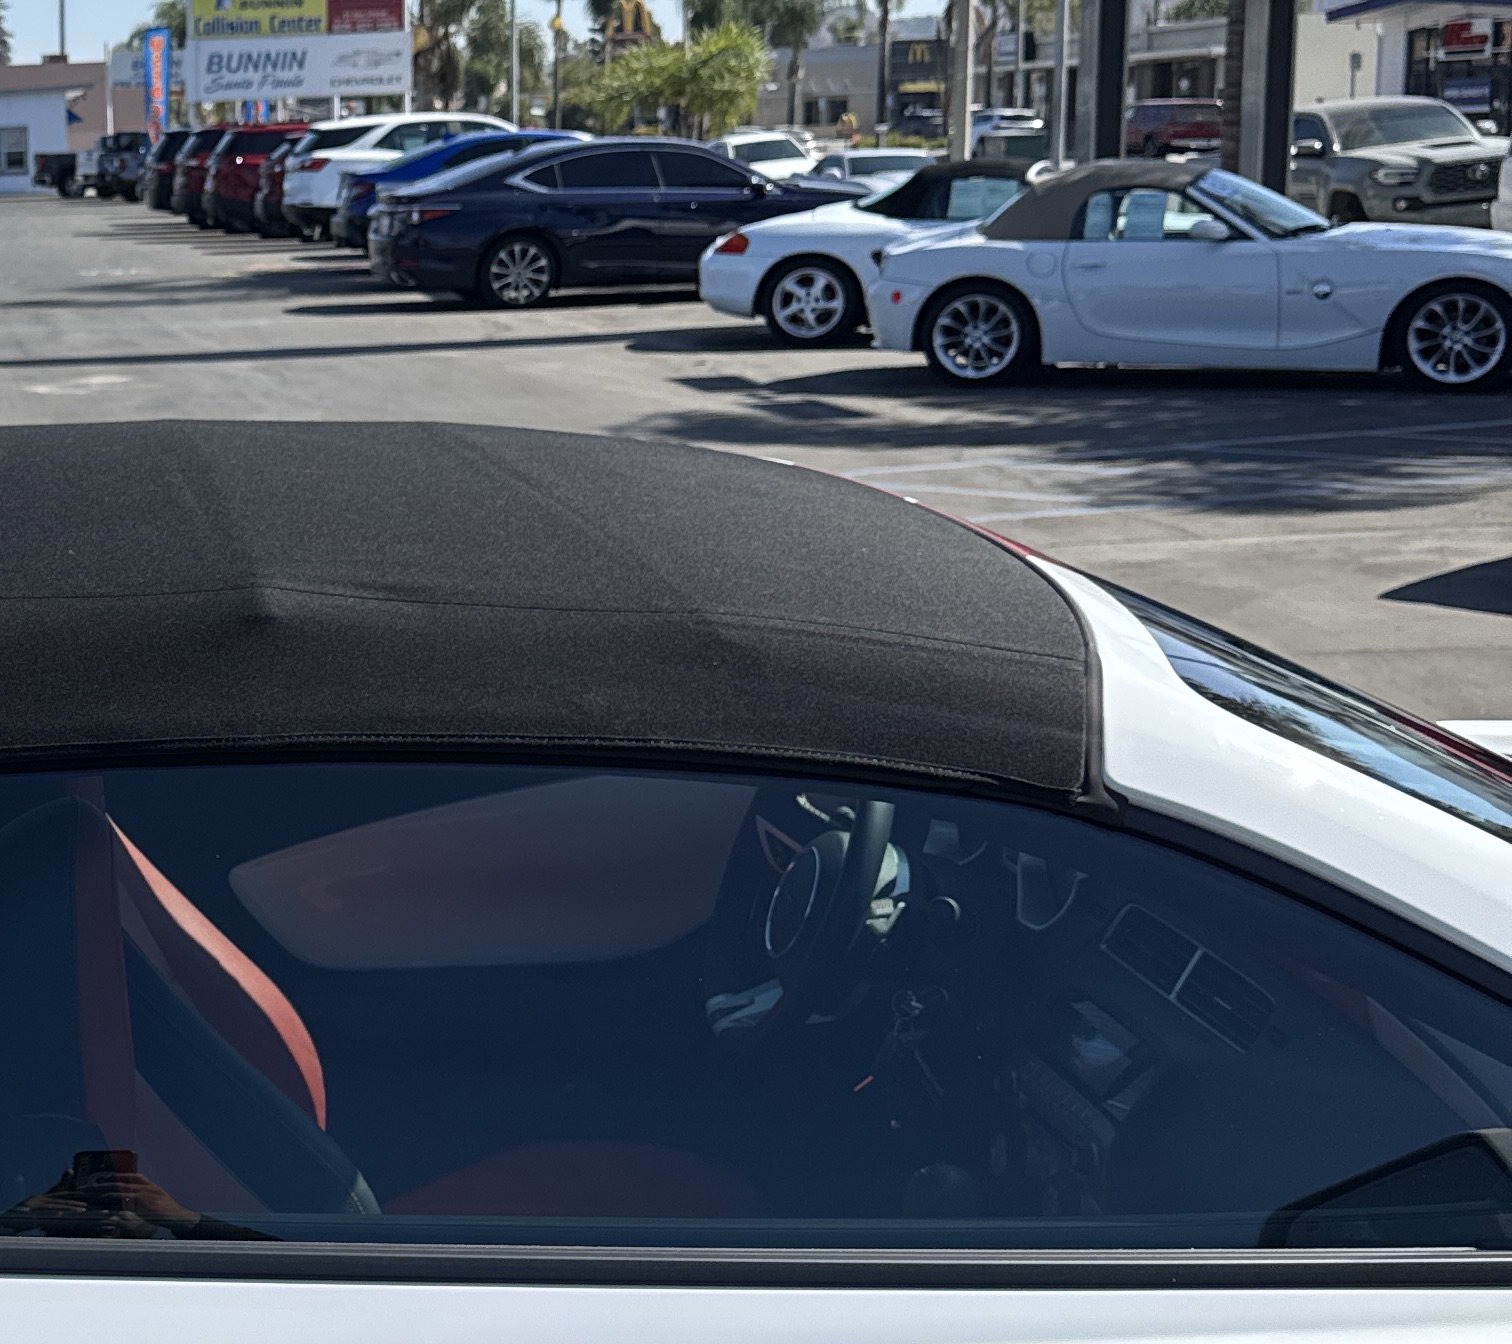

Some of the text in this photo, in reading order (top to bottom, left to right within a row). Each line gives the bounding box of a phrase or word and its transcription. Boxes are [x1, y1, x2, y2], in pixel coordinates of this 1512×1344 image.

[193, 16, 261, 36] Collision
[268, 14, 323, 33] Center
[206, 50, 308, 75] BUNNIN
